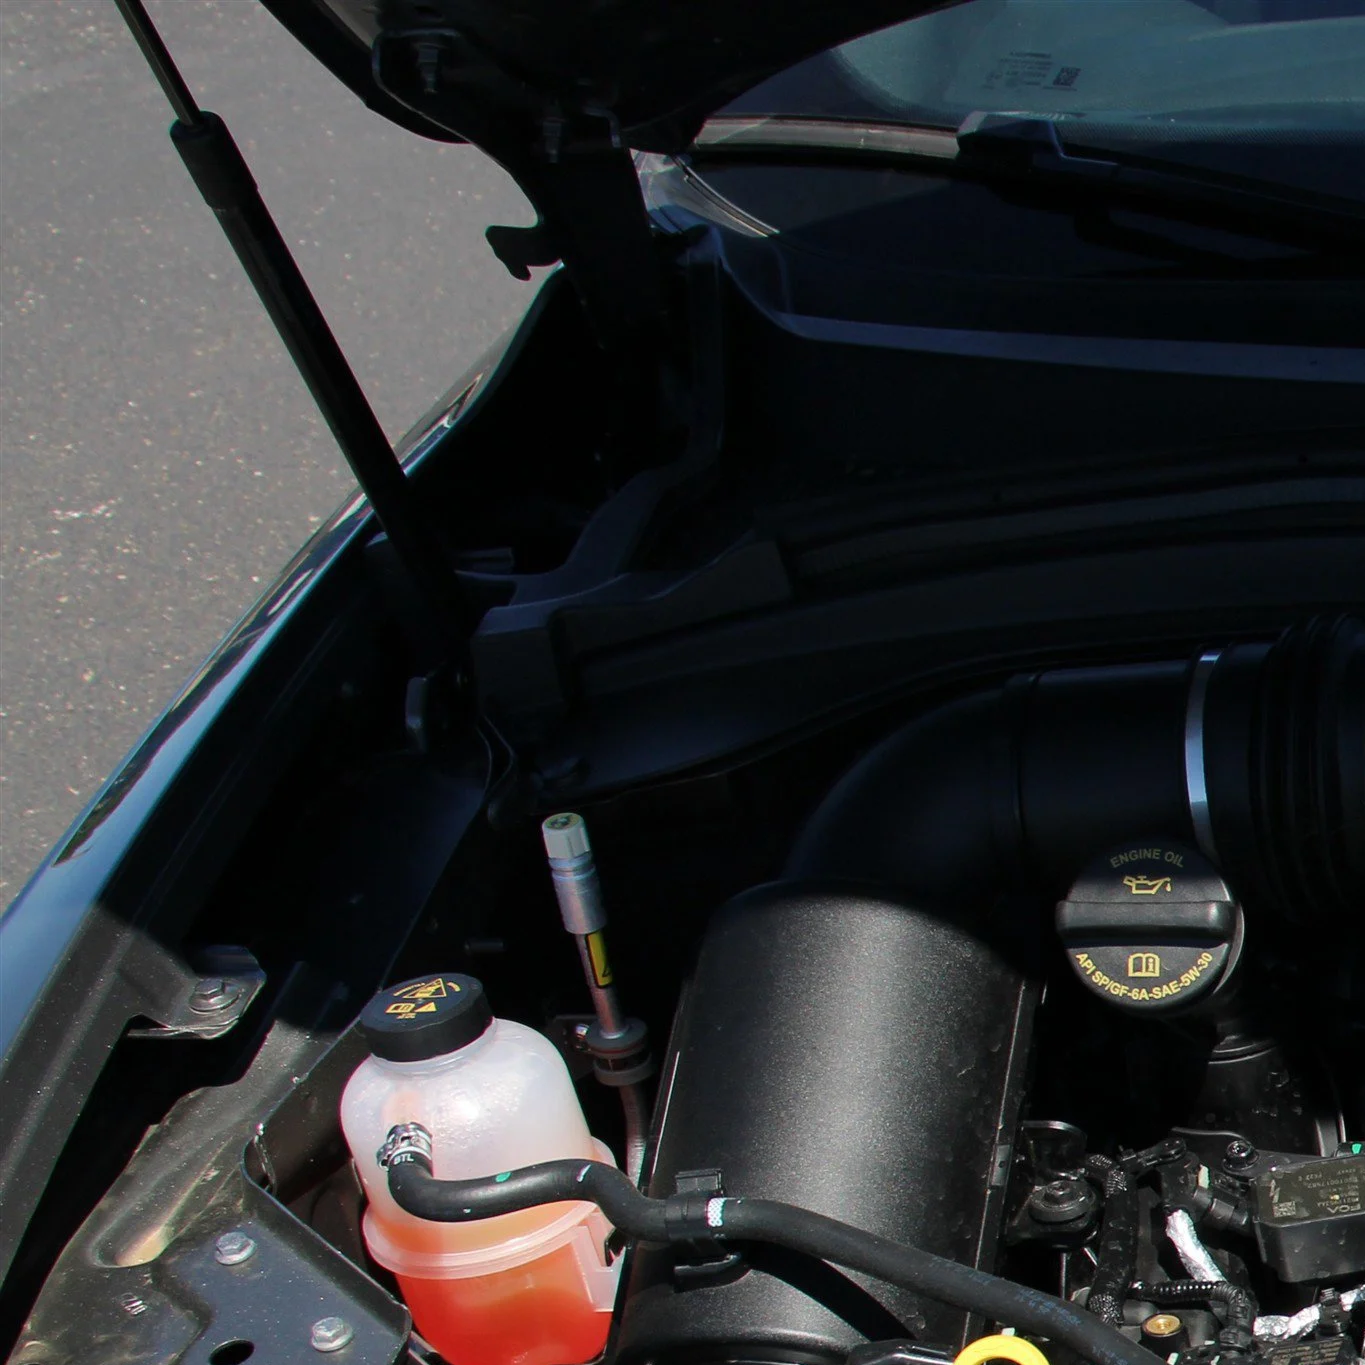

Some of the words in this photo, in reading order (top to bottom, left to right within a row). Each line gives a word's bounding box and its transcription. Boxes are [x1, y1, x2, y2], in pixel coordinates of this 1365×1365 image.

[1109, 848, 1161, 869] ENGINE
[1164, 850, 1185, 868] OIL
[1075, 952, 1095, 976] API
[1091, 951, 1214, 1001] SP/GF-6A-SAE-5W-30
